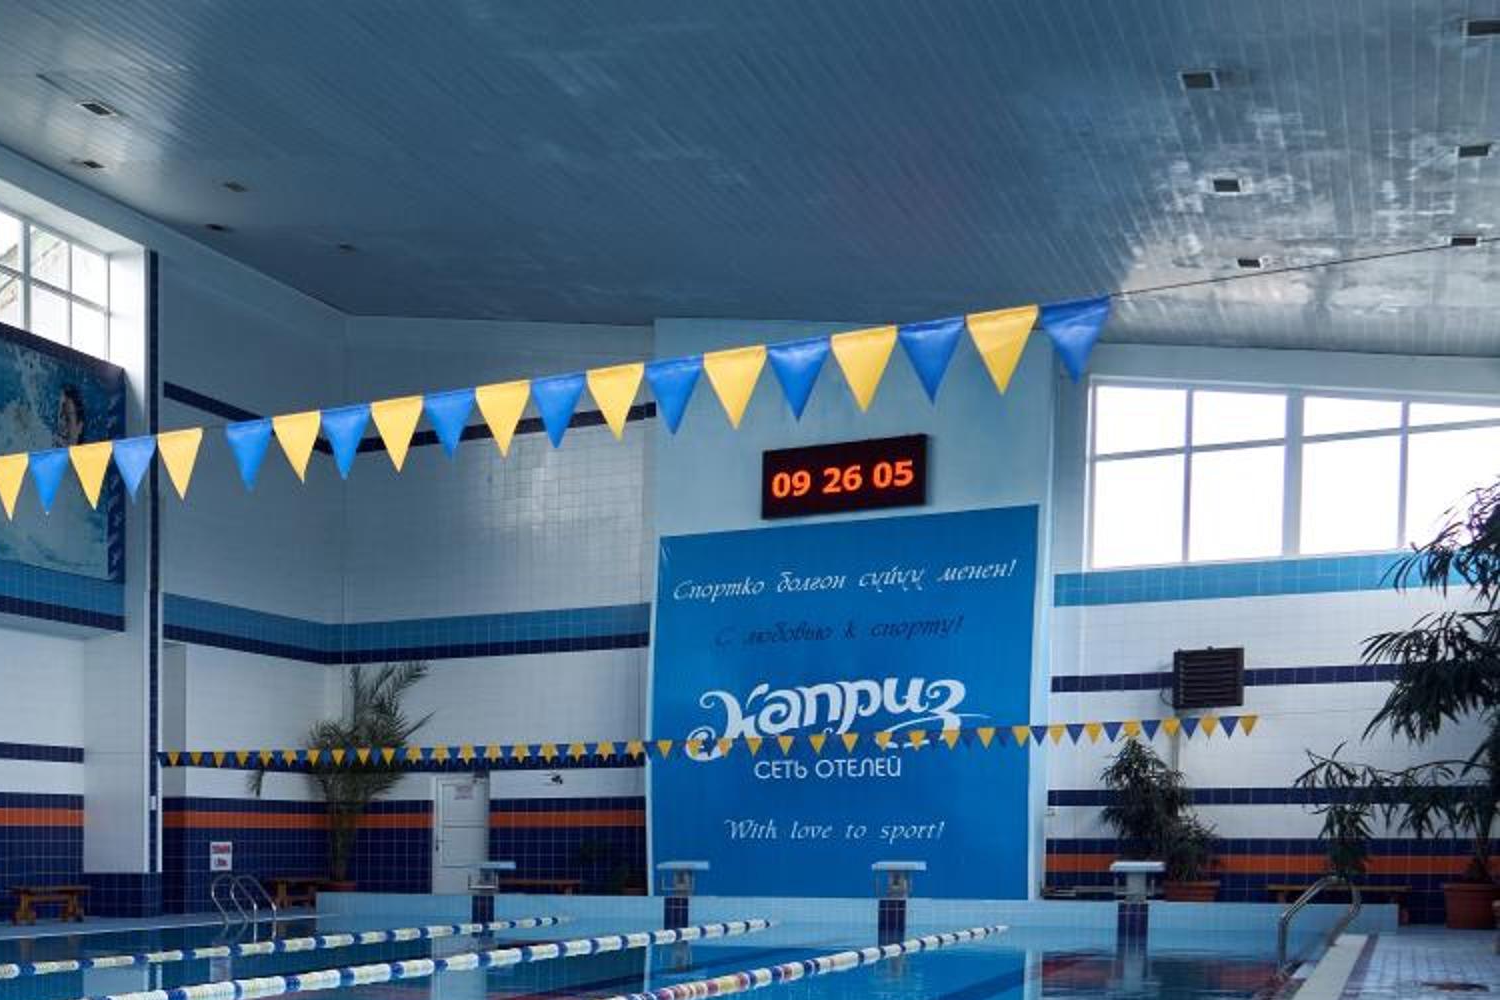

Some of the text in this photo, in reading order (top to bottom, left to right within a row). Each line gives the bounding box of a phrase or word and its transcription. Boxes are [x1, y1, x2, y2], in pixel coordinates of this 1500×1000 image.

[771, 459, 914, 498] 09 26 05
[673, 577, 765, 603] Спортко
[777, 571, 846, 593] болгон
[935, 559, 1017, 583] менен!
[685, 677, 970, 762] Каприз
[753, 755, 902, 780] СЕТЬ ОТЕЛЕЙ
[723, 818, 946, 845] With love to sport!
